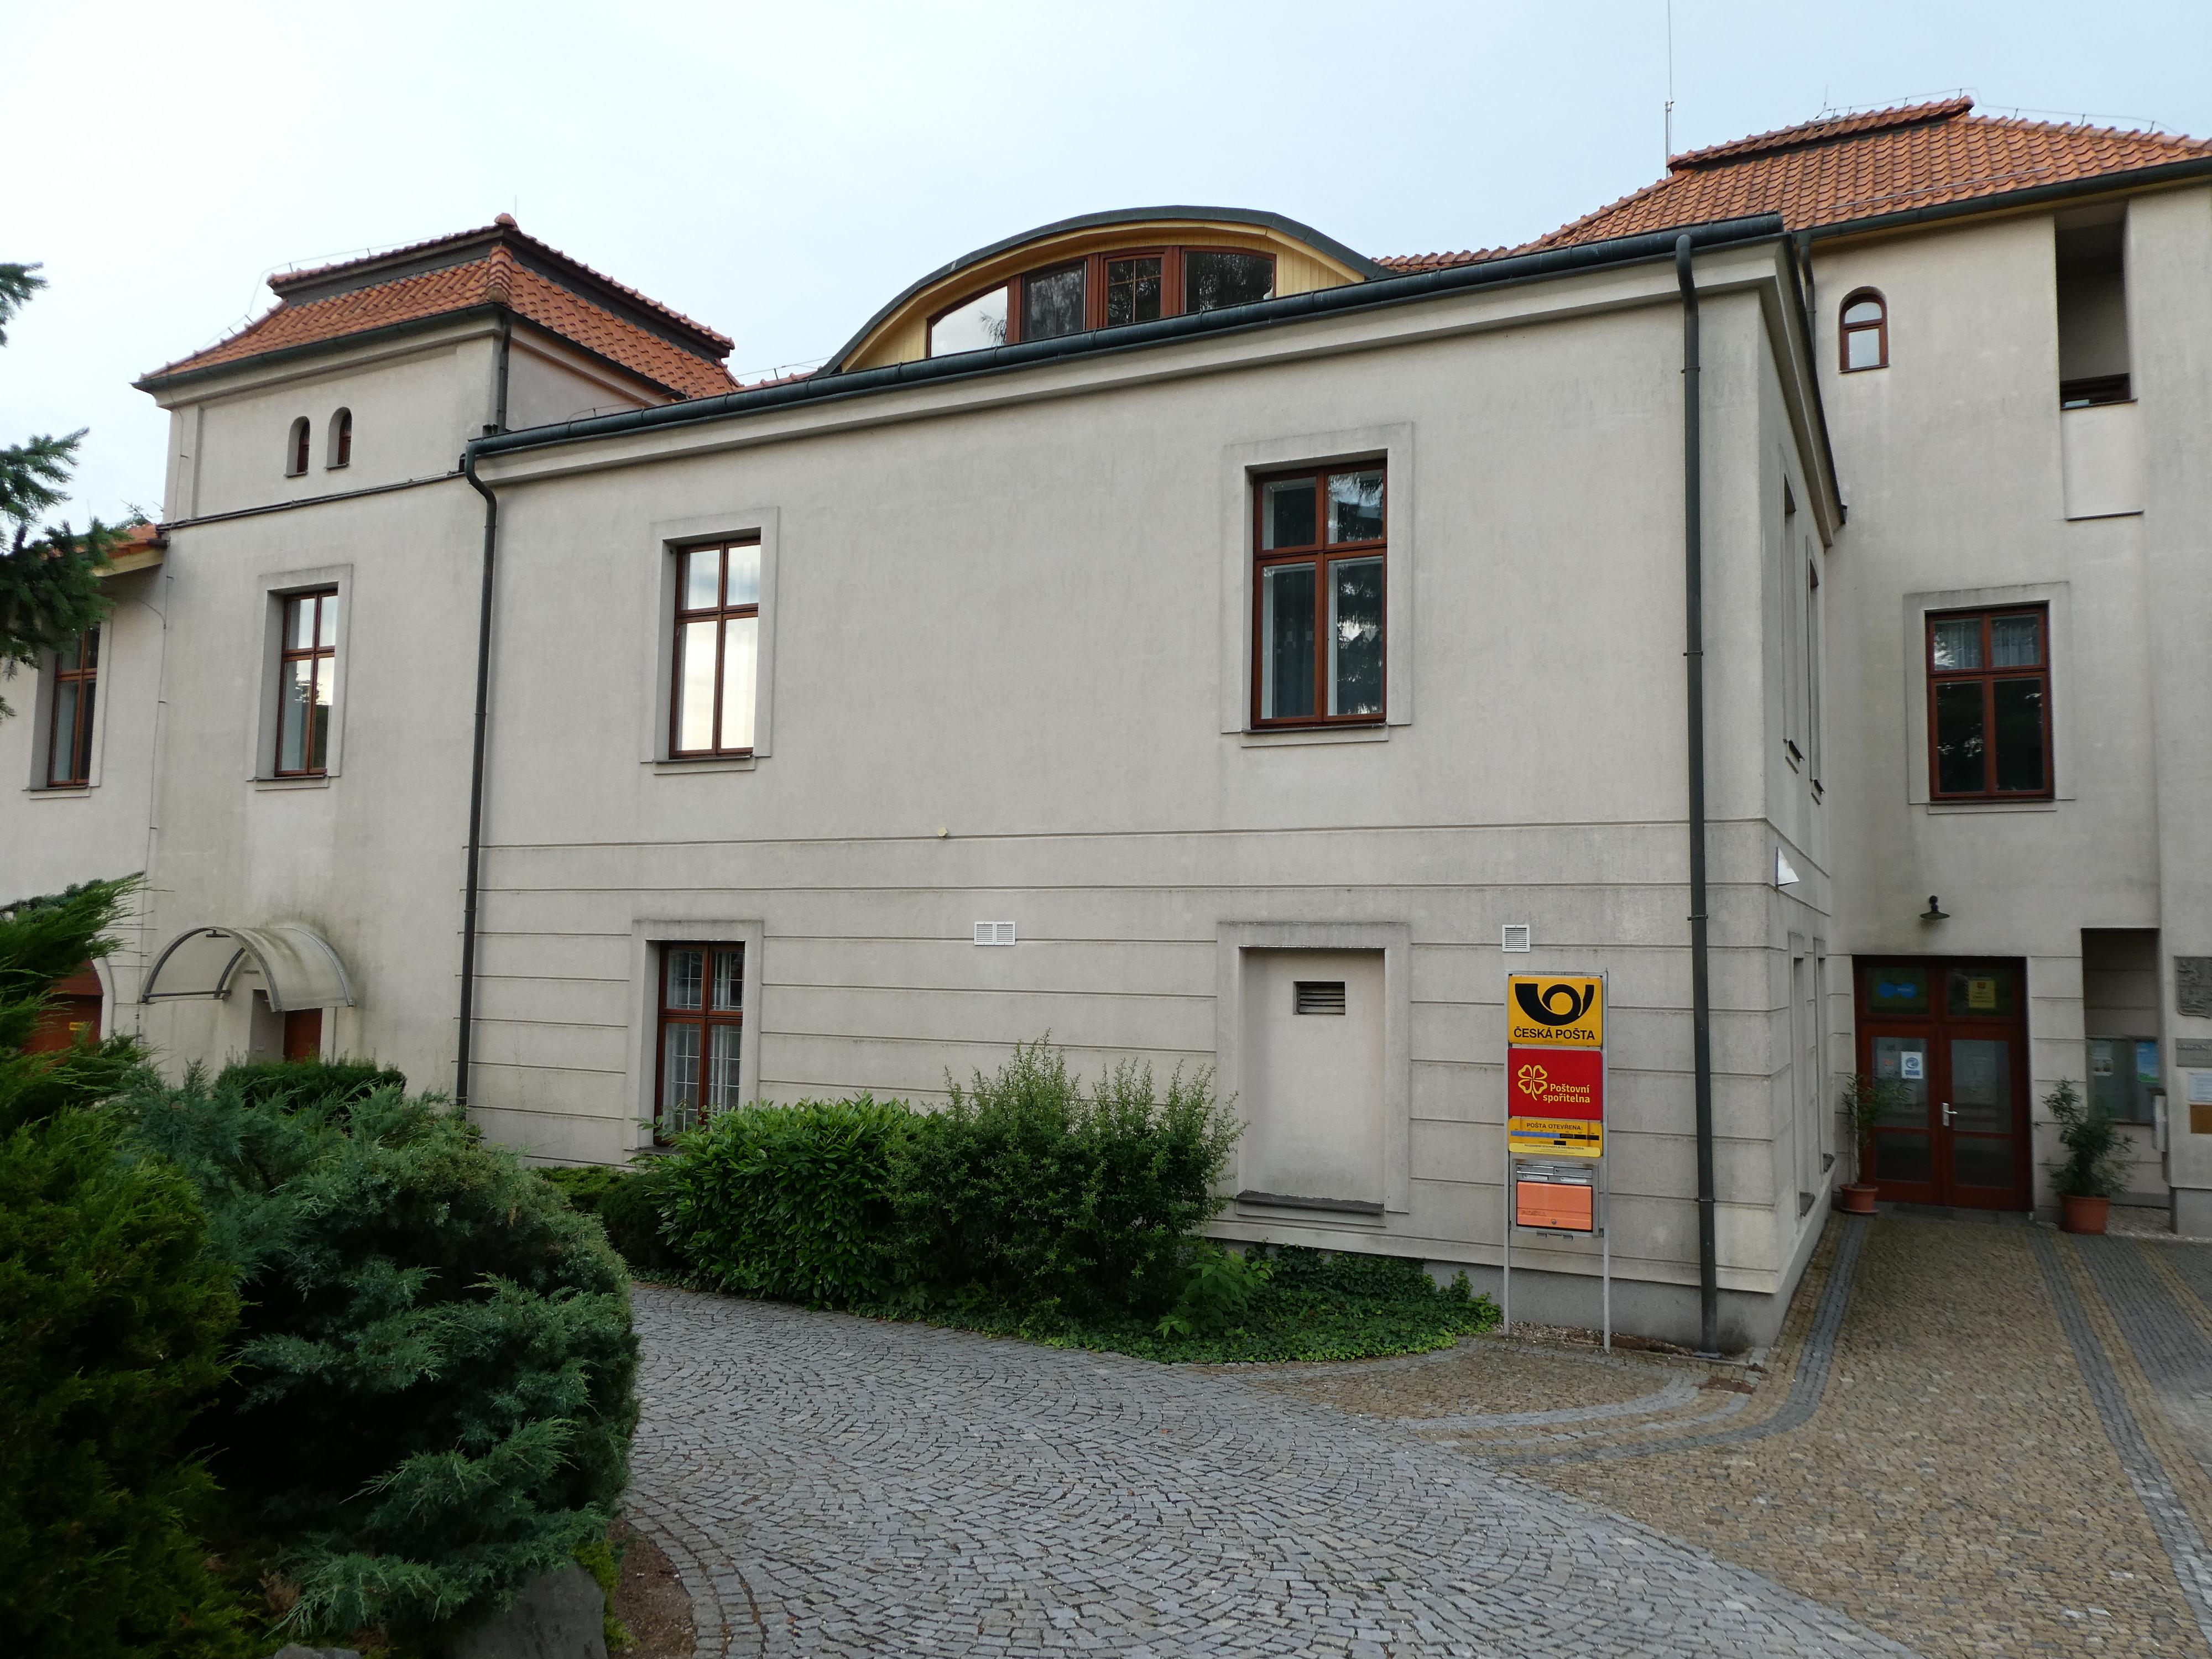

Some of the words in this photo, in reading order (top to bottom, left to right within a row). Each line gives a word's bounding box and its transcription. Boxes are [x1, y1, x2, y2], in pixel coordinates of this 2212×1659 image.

[1514, 1026, 1553, 1039] ČESKÁ
[1556, 1028, 1595, 1040] POŠTA
[1550, 1083, 1590, 1093] Poštovní
[1543, 1093, 1590, 1103] spořitelna
